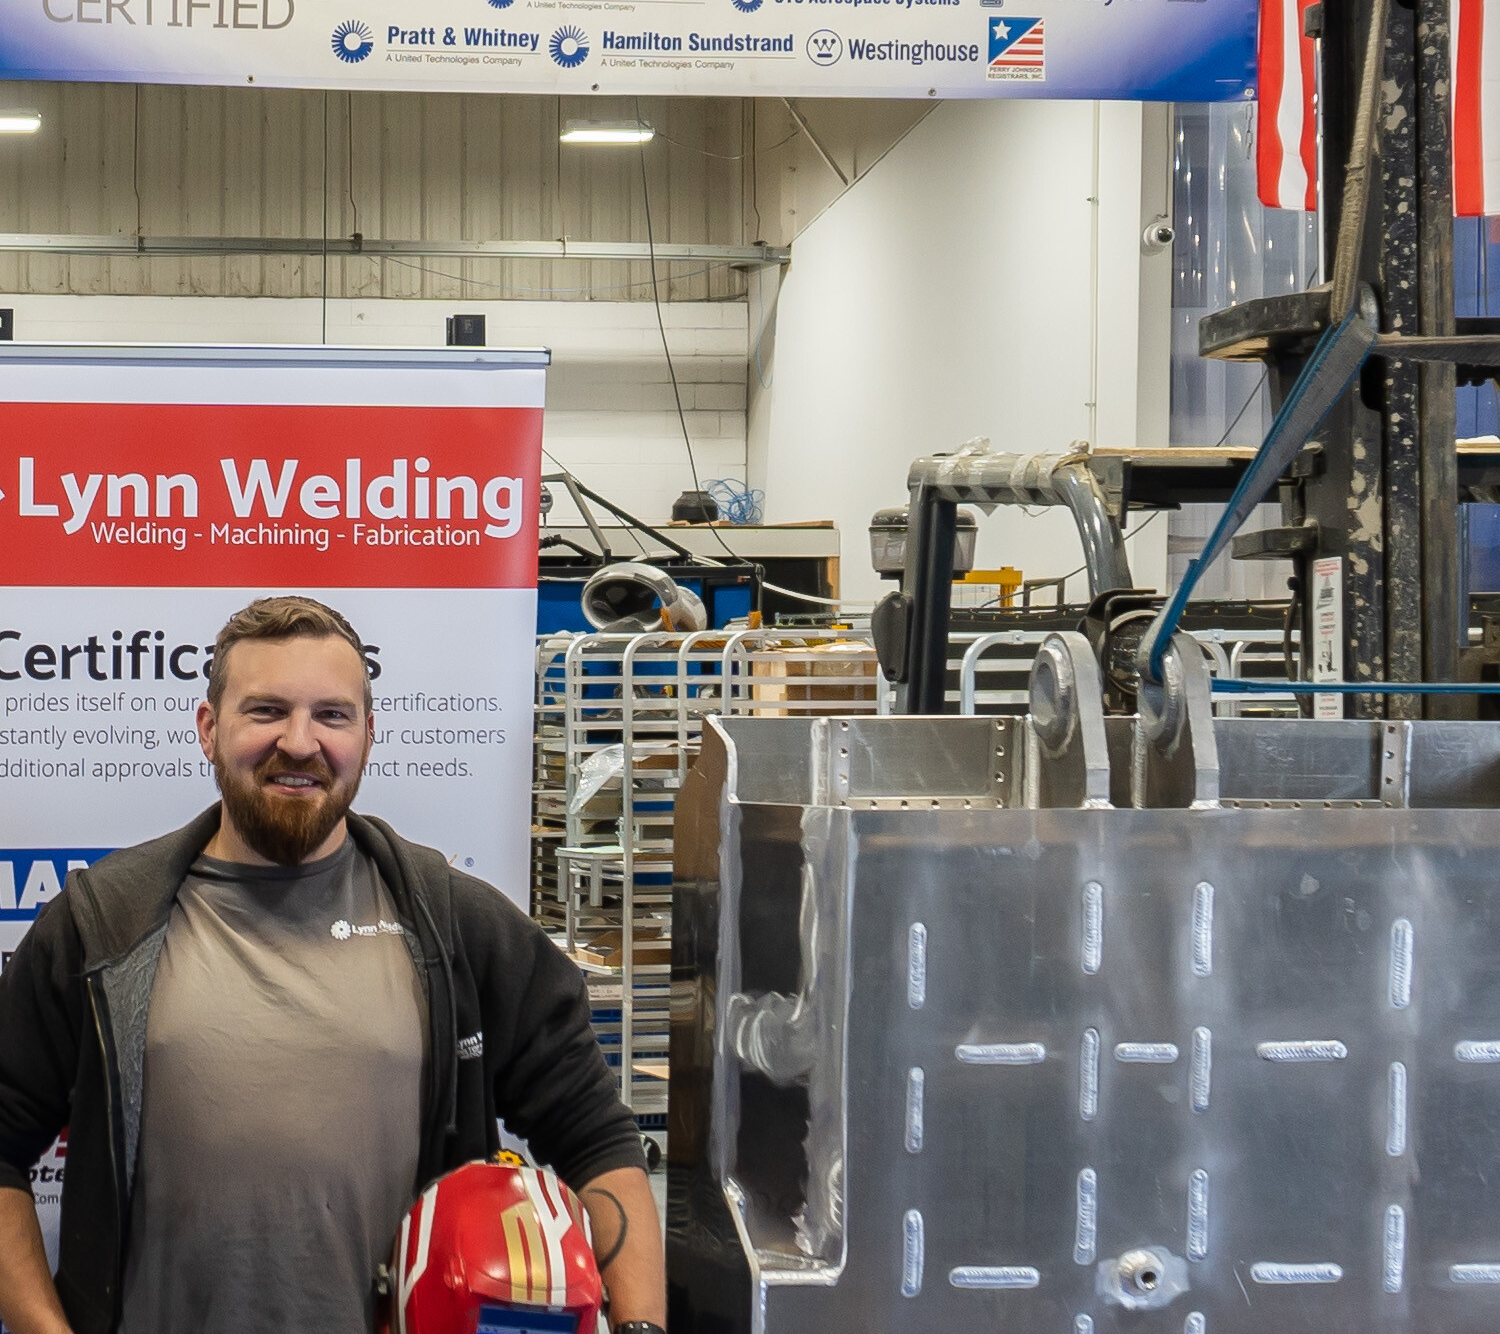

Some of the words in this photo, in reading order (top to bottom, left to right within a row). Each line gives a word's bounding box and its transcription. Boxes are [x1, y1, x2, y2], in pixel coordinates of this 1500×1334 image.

[387, 25, 438, 46] Pratt
[443, 27, 457, 46] &
[463, 27, 541, 52] Whitney
[602, 30, 682, 52] Hamilton
[688, 33, 794, 55] Sundstrand
[848, 38, 979, 64] Westinghouse
[385, 54, 393, 63] A
[395, 54, 423, 64] United
[425, 55, 480, 67] Technologies
[483, 56, 523, 68] Company
[601, 58, 608, 67] A
[610, 58, 637, 68] United
[638, 59, 693, 71] Technologies
[695, 60, 736, 72] Company
[19, 457, 199, 535] Lynn
[220, 455, 525, 540] Welding
[91, 520, 188, 552] Welding
[210, 521, 330, 552] Machining
[353, 523, 481, 547] Fabrication
[5, 692, 70, 717] prides
[77, 692, 126, 712] itself
[130, 697, 156, 712] on
[164, 696, 200, 712] our
[372, 692, 502, 712] certifications.
[73, 724, 160, 750] evolving,
[371, 729, 394, 744] ur
[400, 728, 506, 745] customers
[91, 758, 193, 782] approvals
[406, 757, 474, 777] needs.
[351, 923, 378, 936] Lynn
